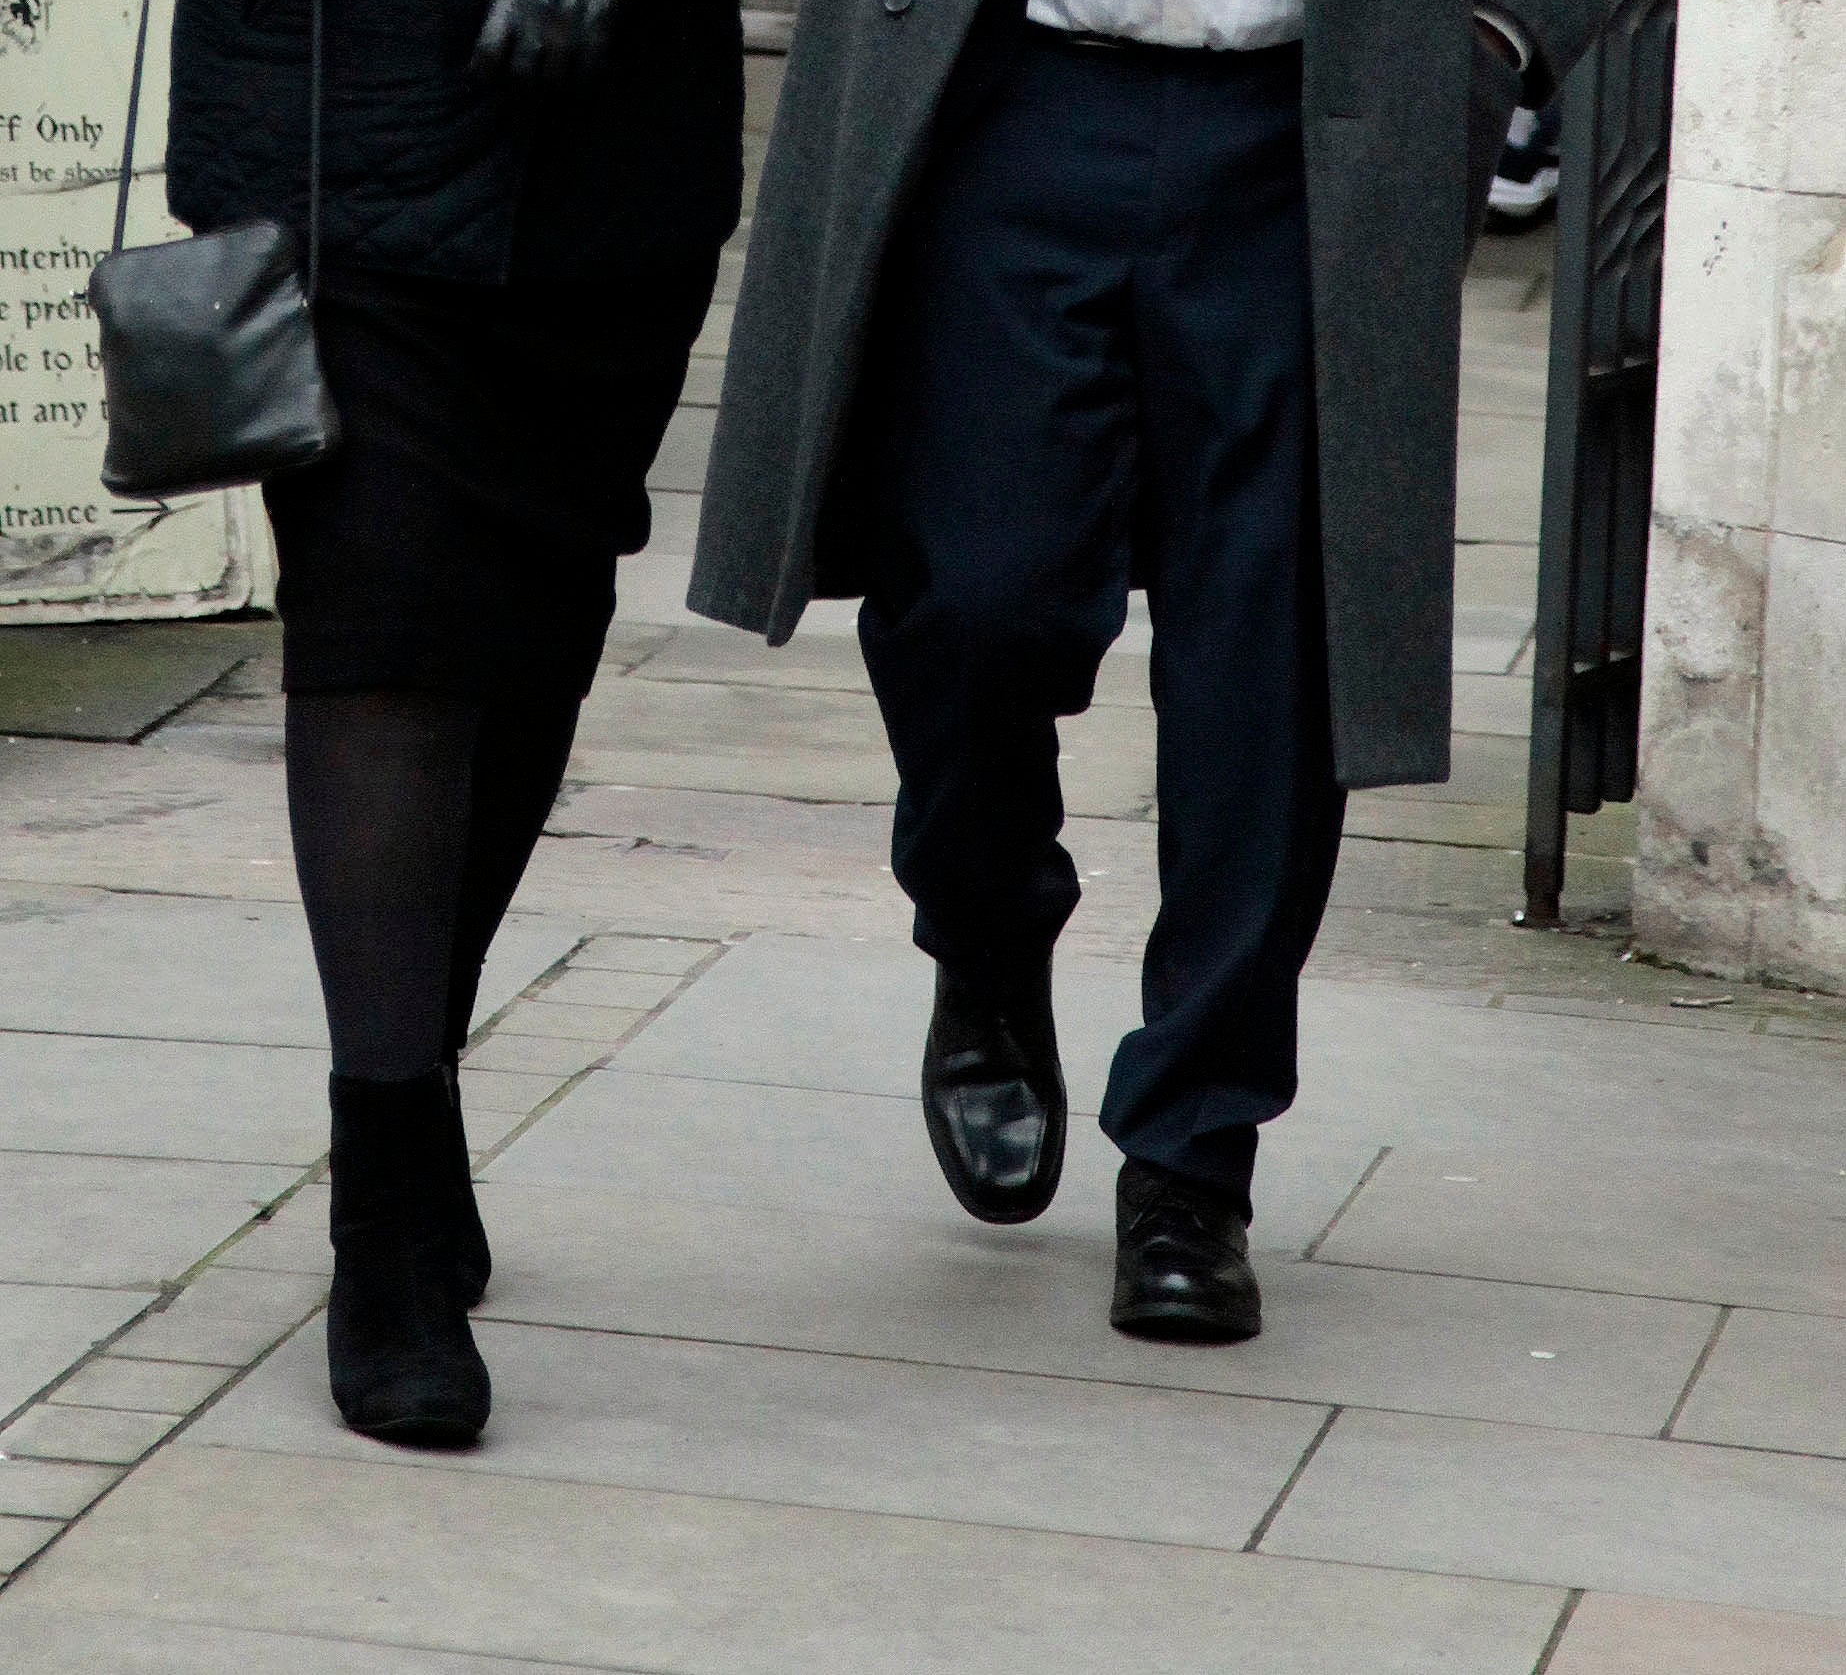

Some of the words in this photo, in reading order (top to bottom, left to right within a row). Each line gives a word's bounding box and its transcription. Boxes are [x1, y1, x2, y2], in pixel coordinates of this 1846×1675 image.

[36, 112, 104, 150] Only
[42, 349, 72, 371] to
[34, 402, 88, 428] any
